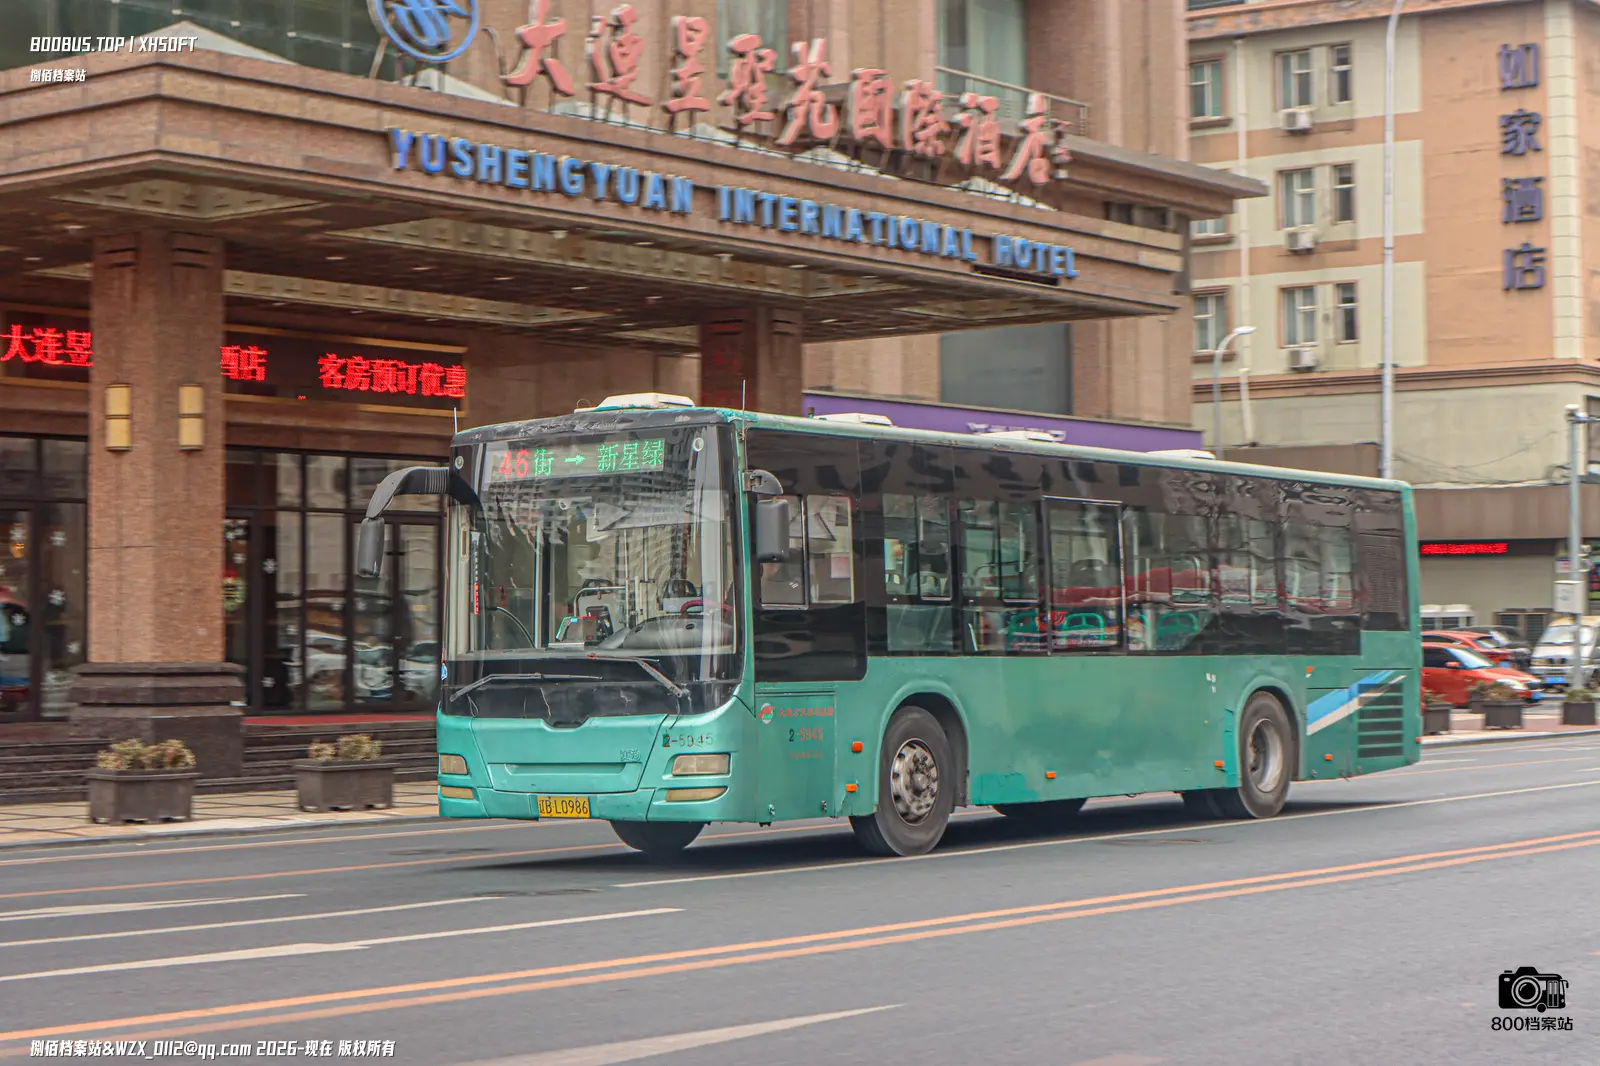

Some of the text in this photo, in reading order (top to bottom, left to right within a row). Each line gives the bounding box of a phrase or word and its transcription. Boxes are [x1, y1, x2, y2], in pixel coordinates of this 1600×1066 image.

[389, 127, 1080, 278] YUSHENGYUAN INTERNATIONAL HOTEL
[1497, 42, 1547, 291] 如家酒店
[0, 324, 94, 367] 大连昱
[317, 353, 467, 397] 客房预订优惠
[499, 439, 665, 479] 46 街 新星绿
